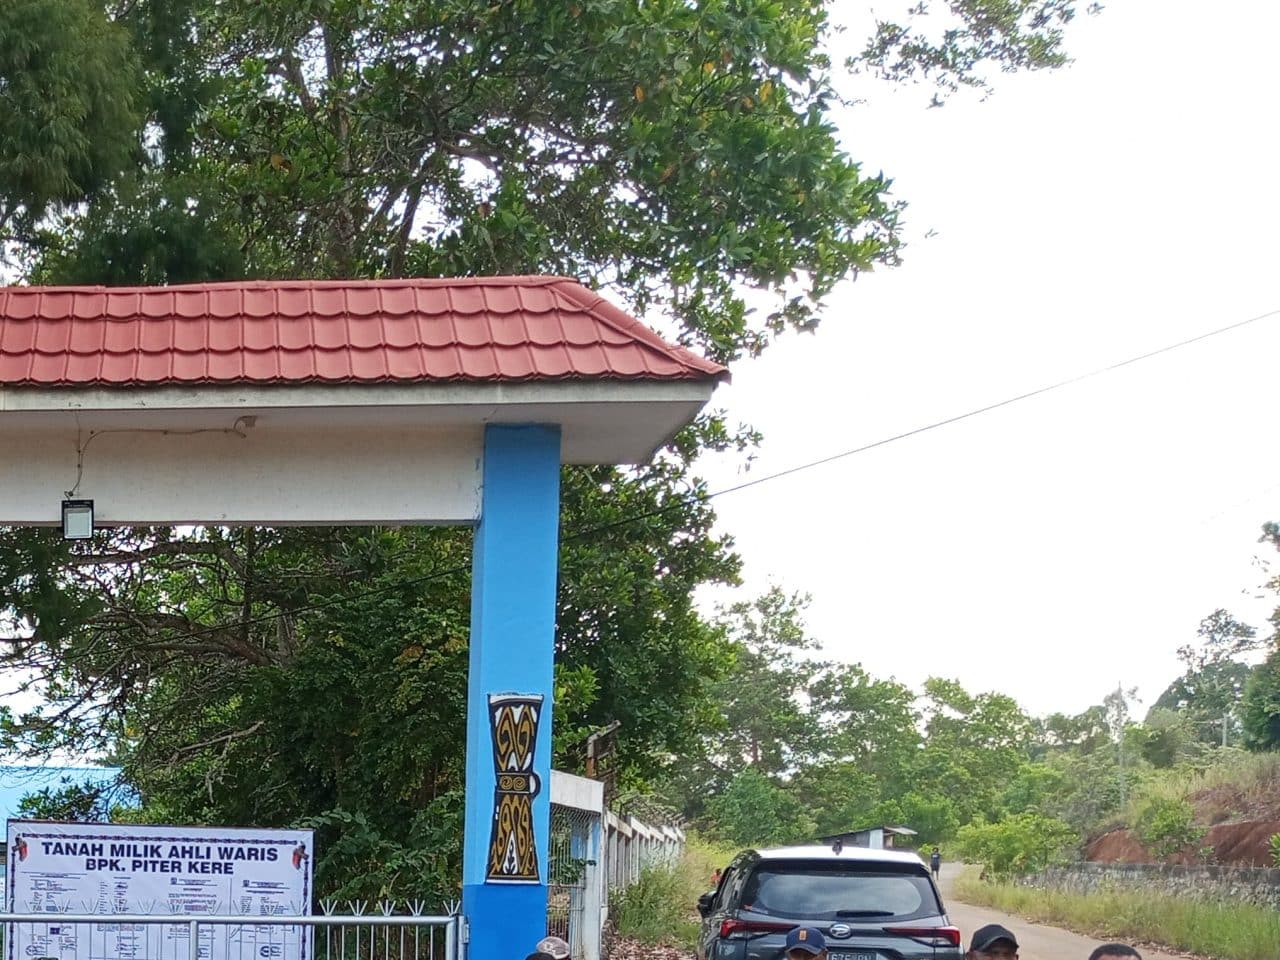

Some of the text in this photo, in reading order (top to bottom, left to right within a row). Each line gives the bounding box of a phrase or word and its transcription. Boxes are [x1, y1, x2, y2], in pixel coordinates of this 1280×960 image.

[41, 842, 279, 861] TANAH MILIK AHLI WARIS
[85, 859, 234, 875] BPK. PITER KERE
